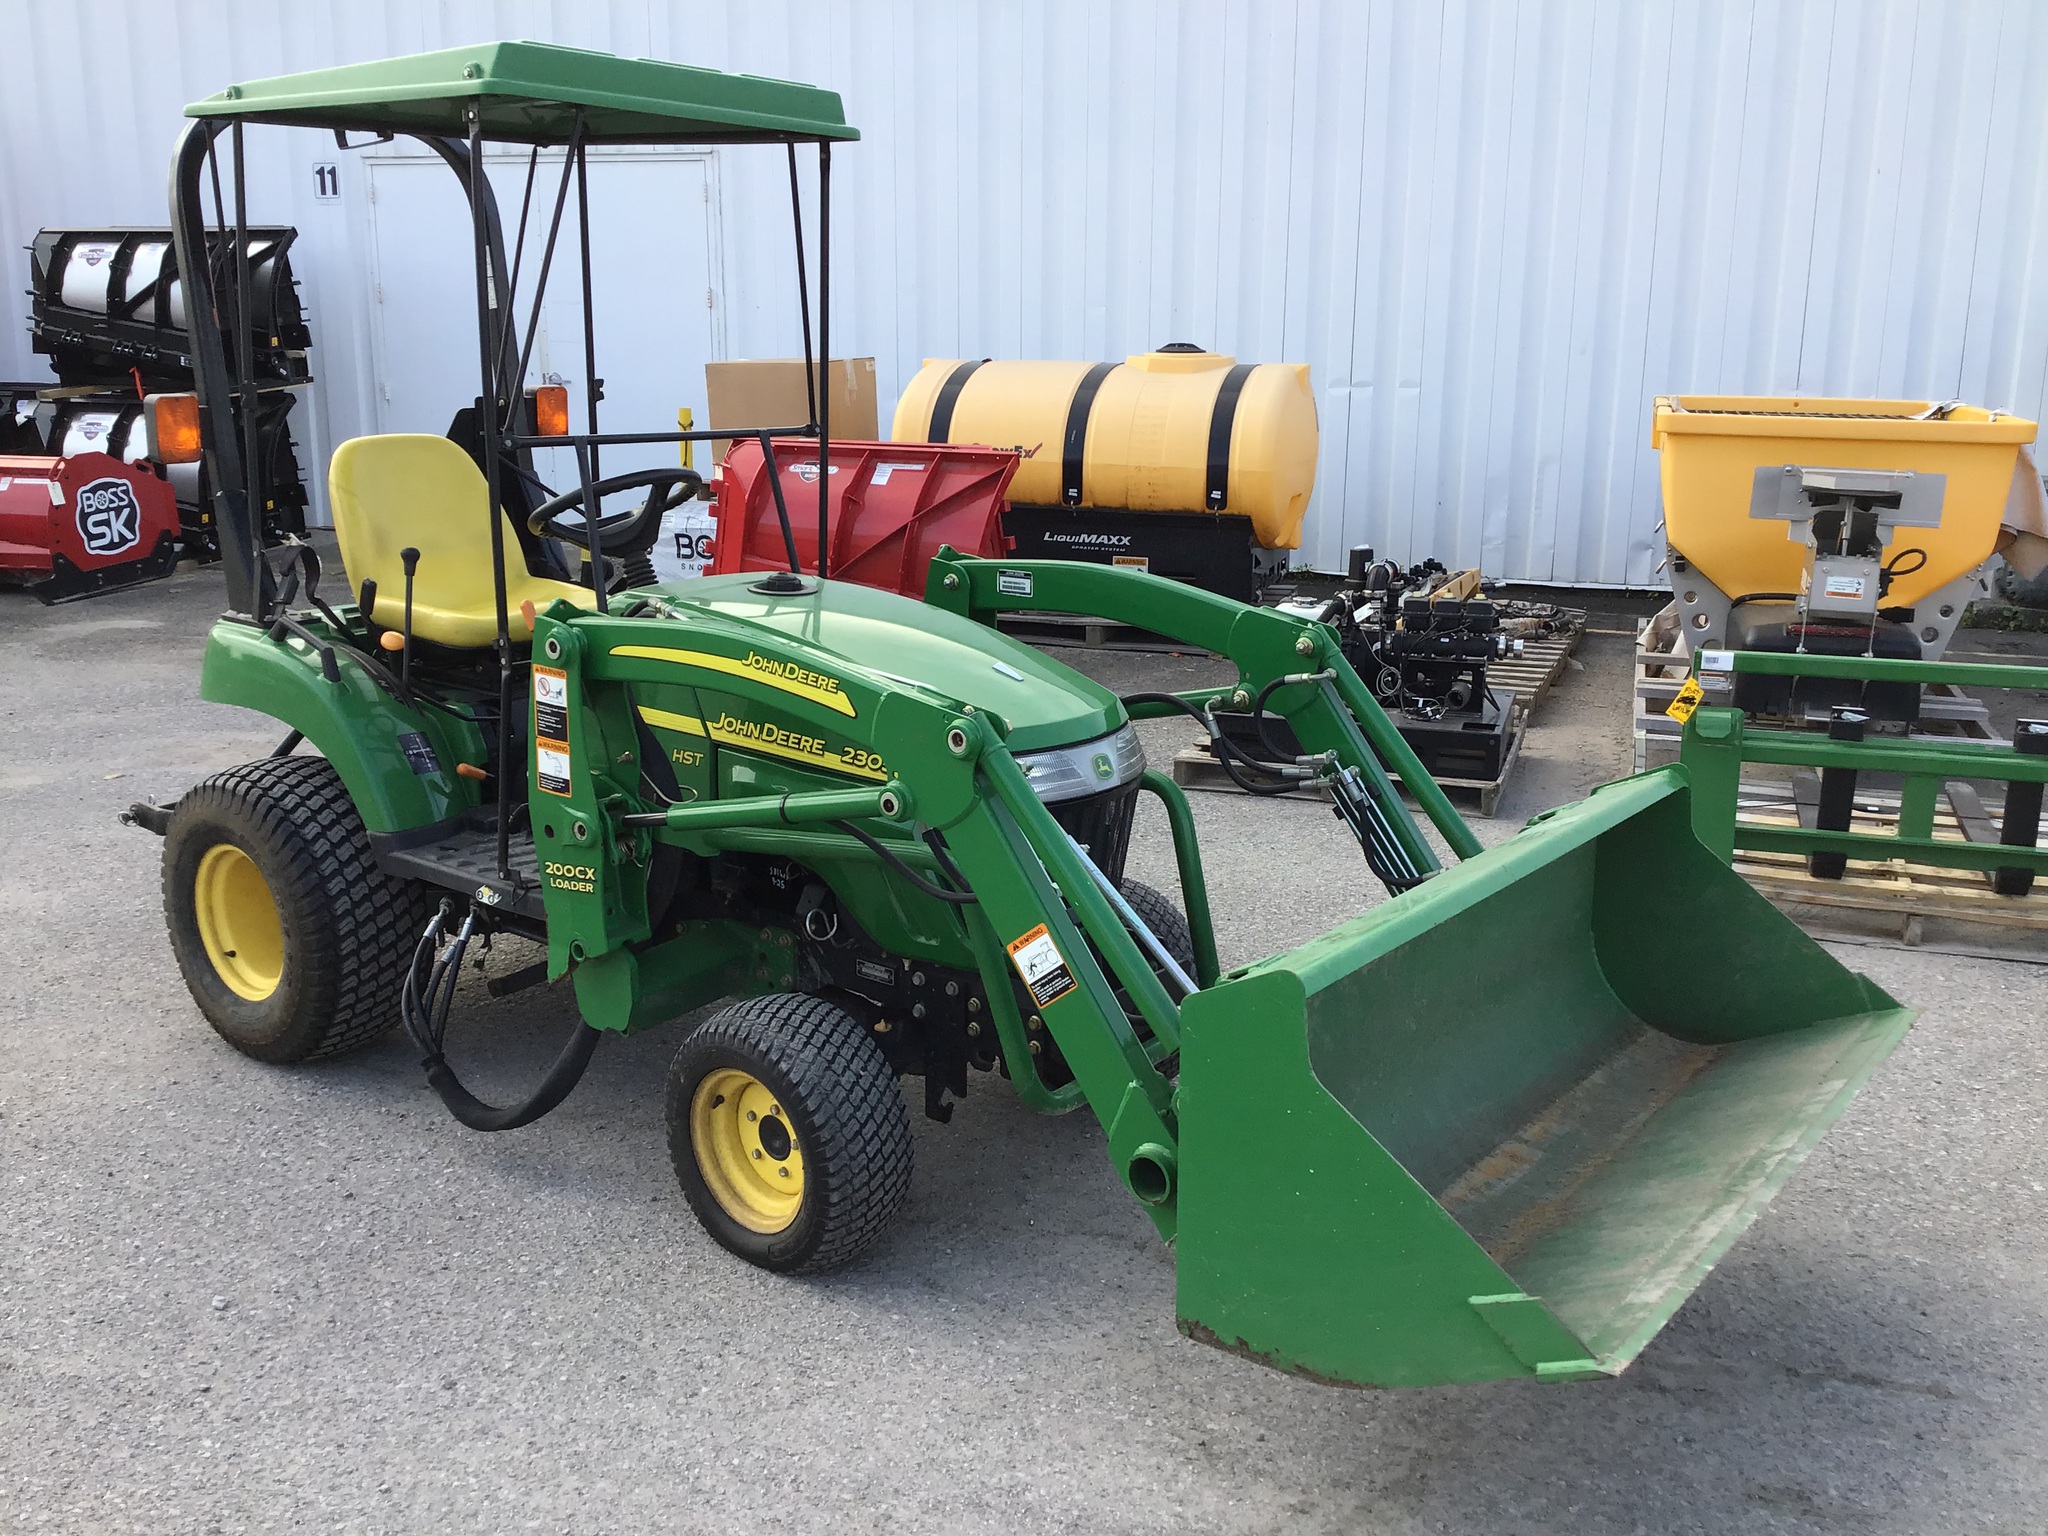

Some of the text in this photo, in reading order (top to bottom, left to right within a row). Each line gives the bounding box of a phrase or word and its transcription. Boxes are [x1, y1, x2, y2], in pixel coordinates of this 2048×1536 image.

[315, 166, 338, 196] 11
[82, 485, 129, 513] BOSS
[86, 507, 135, 548] SK
[674, 533, 715, 560] BO
[681, 563, 703, 571] SNO
[741, 650, 840, 693] JOHN DEERE
[712, 712, 761, 740] JOHN
[761, 722, 827, 756] DEERE
[672, 748, 704, 768] HST
[544, 861, 596, 881] 200CX
[550, 877, 594, 893] LOADER
[1018, 926, 1044, 947] WARNING
